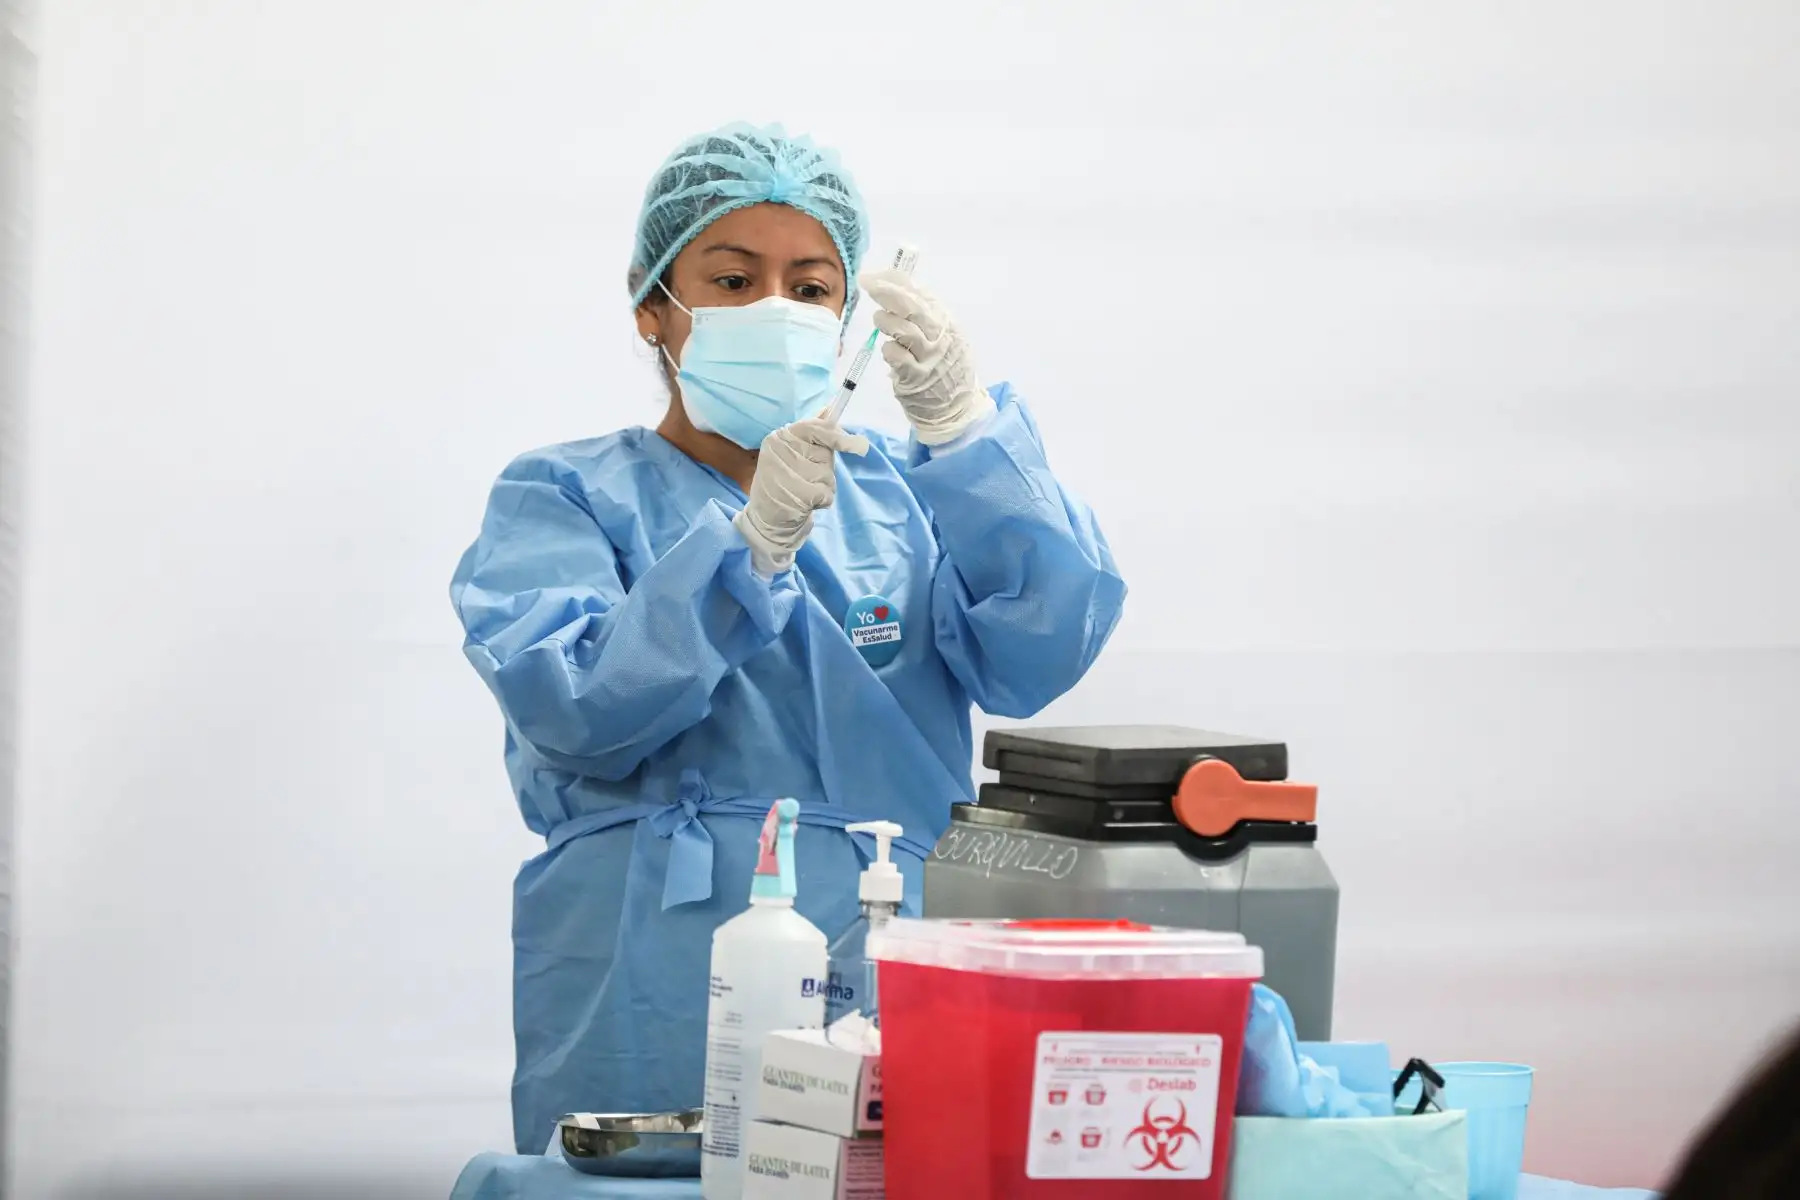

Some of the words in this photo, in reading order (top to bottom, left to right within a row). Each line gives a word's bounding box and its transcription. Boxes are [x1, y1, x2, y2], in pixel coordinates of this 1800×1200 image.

[856, 611, 875, 625] Yo
[853, 625, 898, 637] Vacunarme
[863, 633, 892, 643] EsSalud
[1147, 1077, 1196, 1091] Deslab
